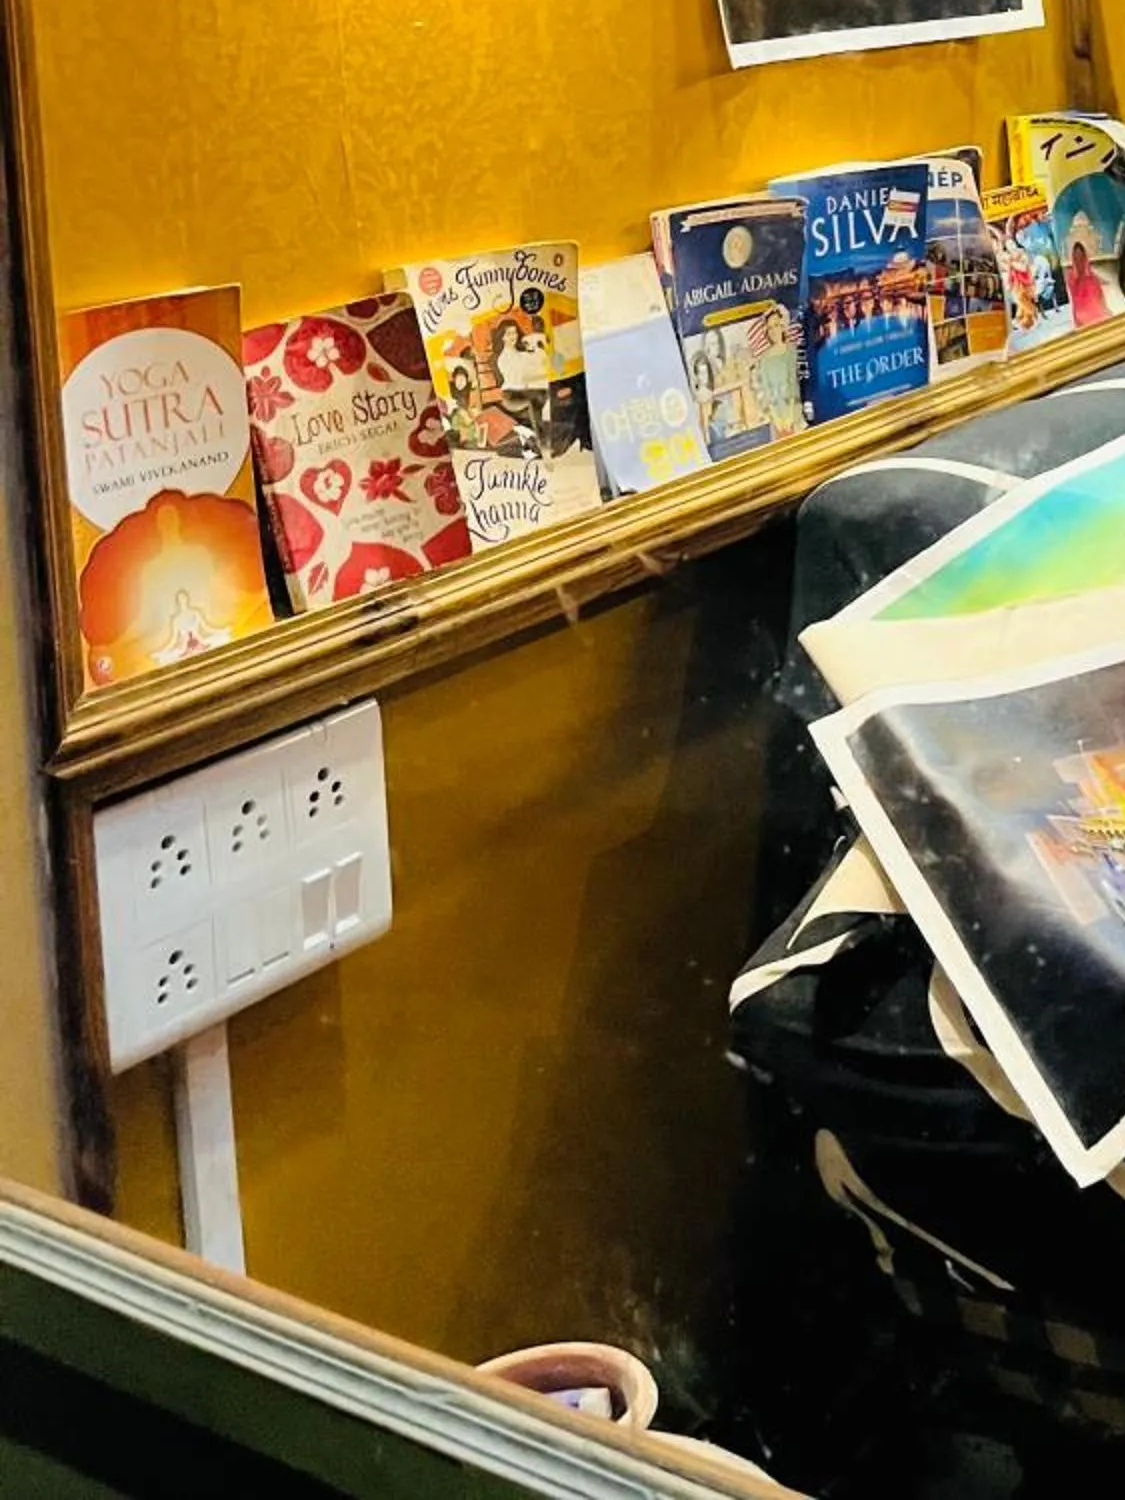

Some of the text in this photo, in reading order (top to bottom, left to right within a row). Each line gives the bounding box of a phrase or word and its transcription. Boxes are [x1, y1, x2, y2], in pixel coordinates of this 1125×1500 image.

[826, 186, 898, 213] DANIE
[683, 268, 799, 310] ABIGAIL ADAMS
[99, 361, 190, 399] YOGA
[826, 347, 925, 389] THE ORDER
[81, 384, 225, 449] SUTRA
[292, 389, 418, 446] Love Story
